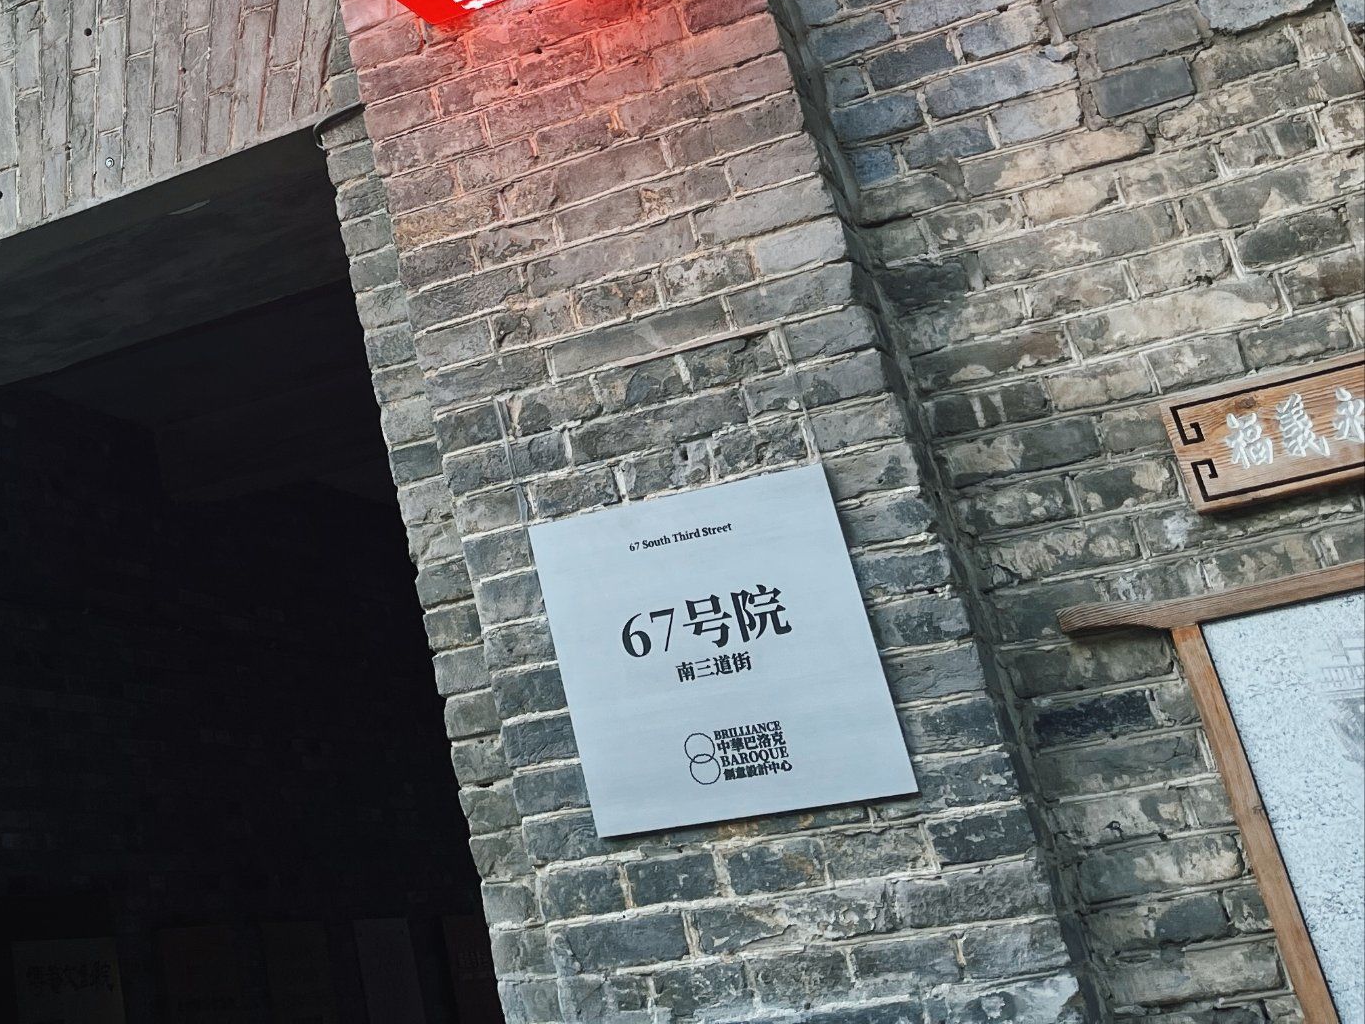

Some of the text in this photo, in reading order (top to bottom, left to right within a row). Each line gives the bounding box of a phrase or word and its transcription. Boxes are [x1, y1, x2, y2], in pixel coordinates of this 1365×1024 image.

[629, 522, 732, 552] 67 South Third Street
[621, 583, 792, 658] 67号院
[675, 651, 752, 682] 南三道街
[713, 720, 782, 740] BRILLIANCE
[716, 731, 786, 754] 中華巴洛克
[720, 746, 789, 767] BAROQUE
